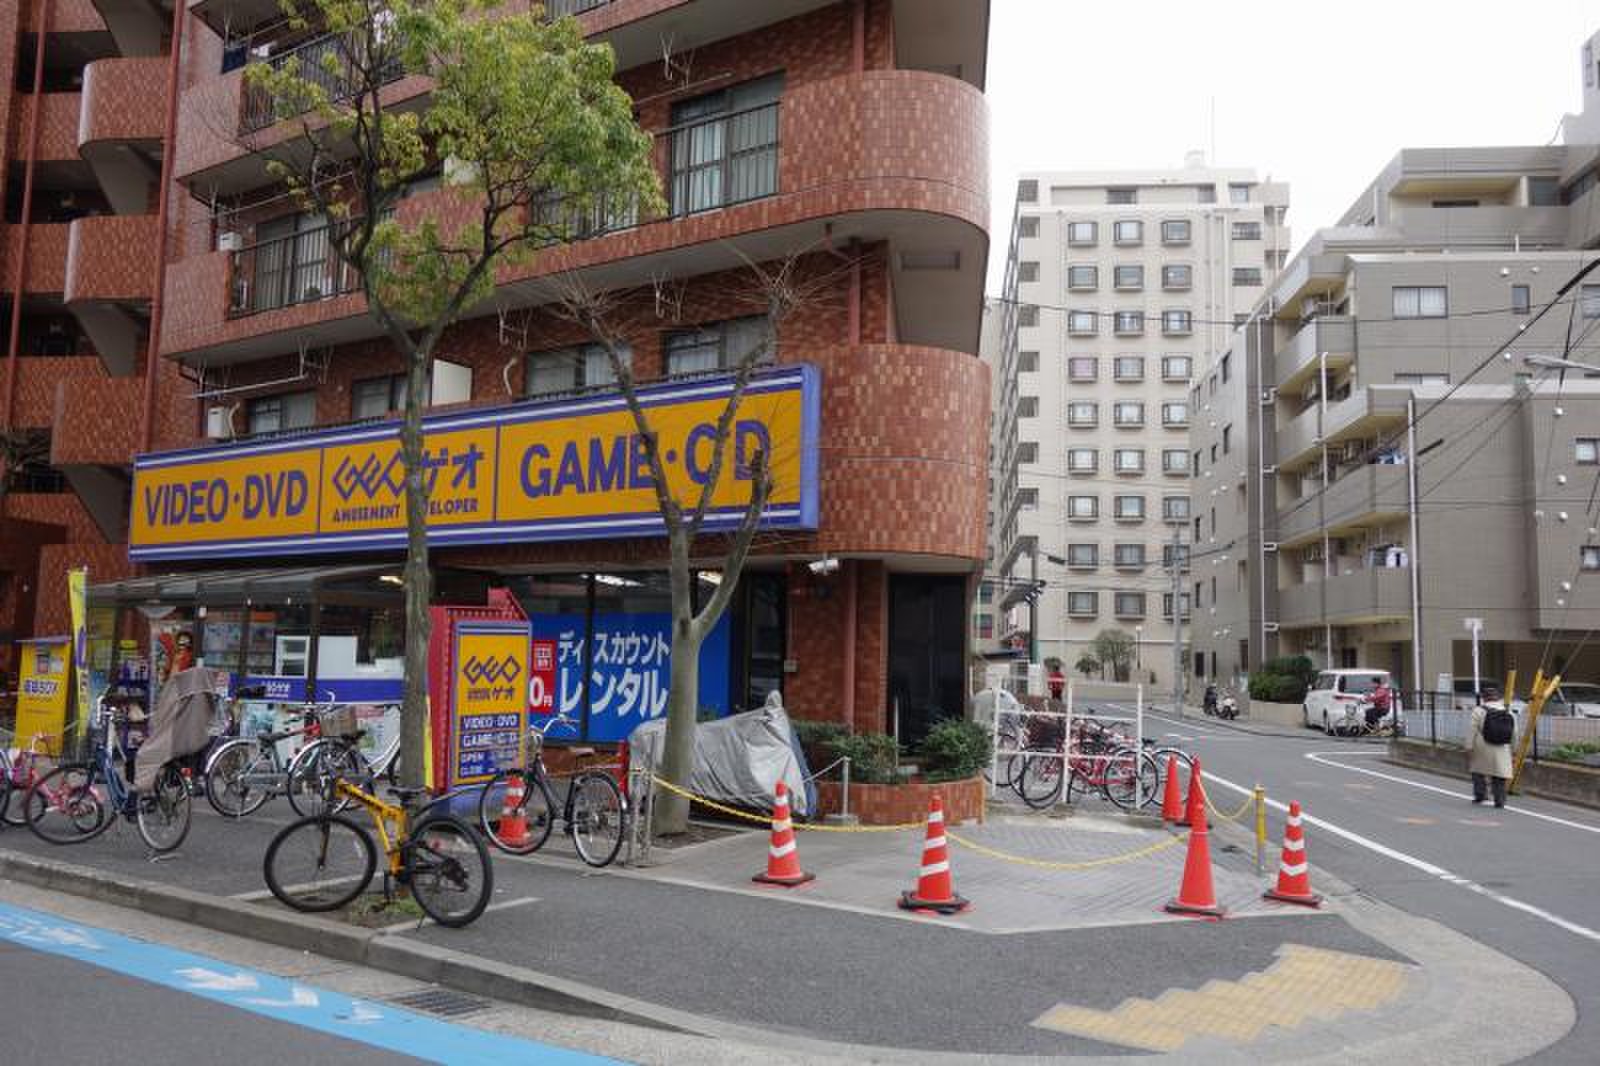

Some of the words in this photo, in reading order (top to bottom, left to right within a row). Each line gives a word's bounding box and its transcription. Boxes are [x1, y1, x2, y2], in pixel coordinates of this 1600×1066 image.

[559, 630, 671, 666] ディスカウント
[463, 656, 521, 685] GEO
[559, 667, 669, 718] レンタル
